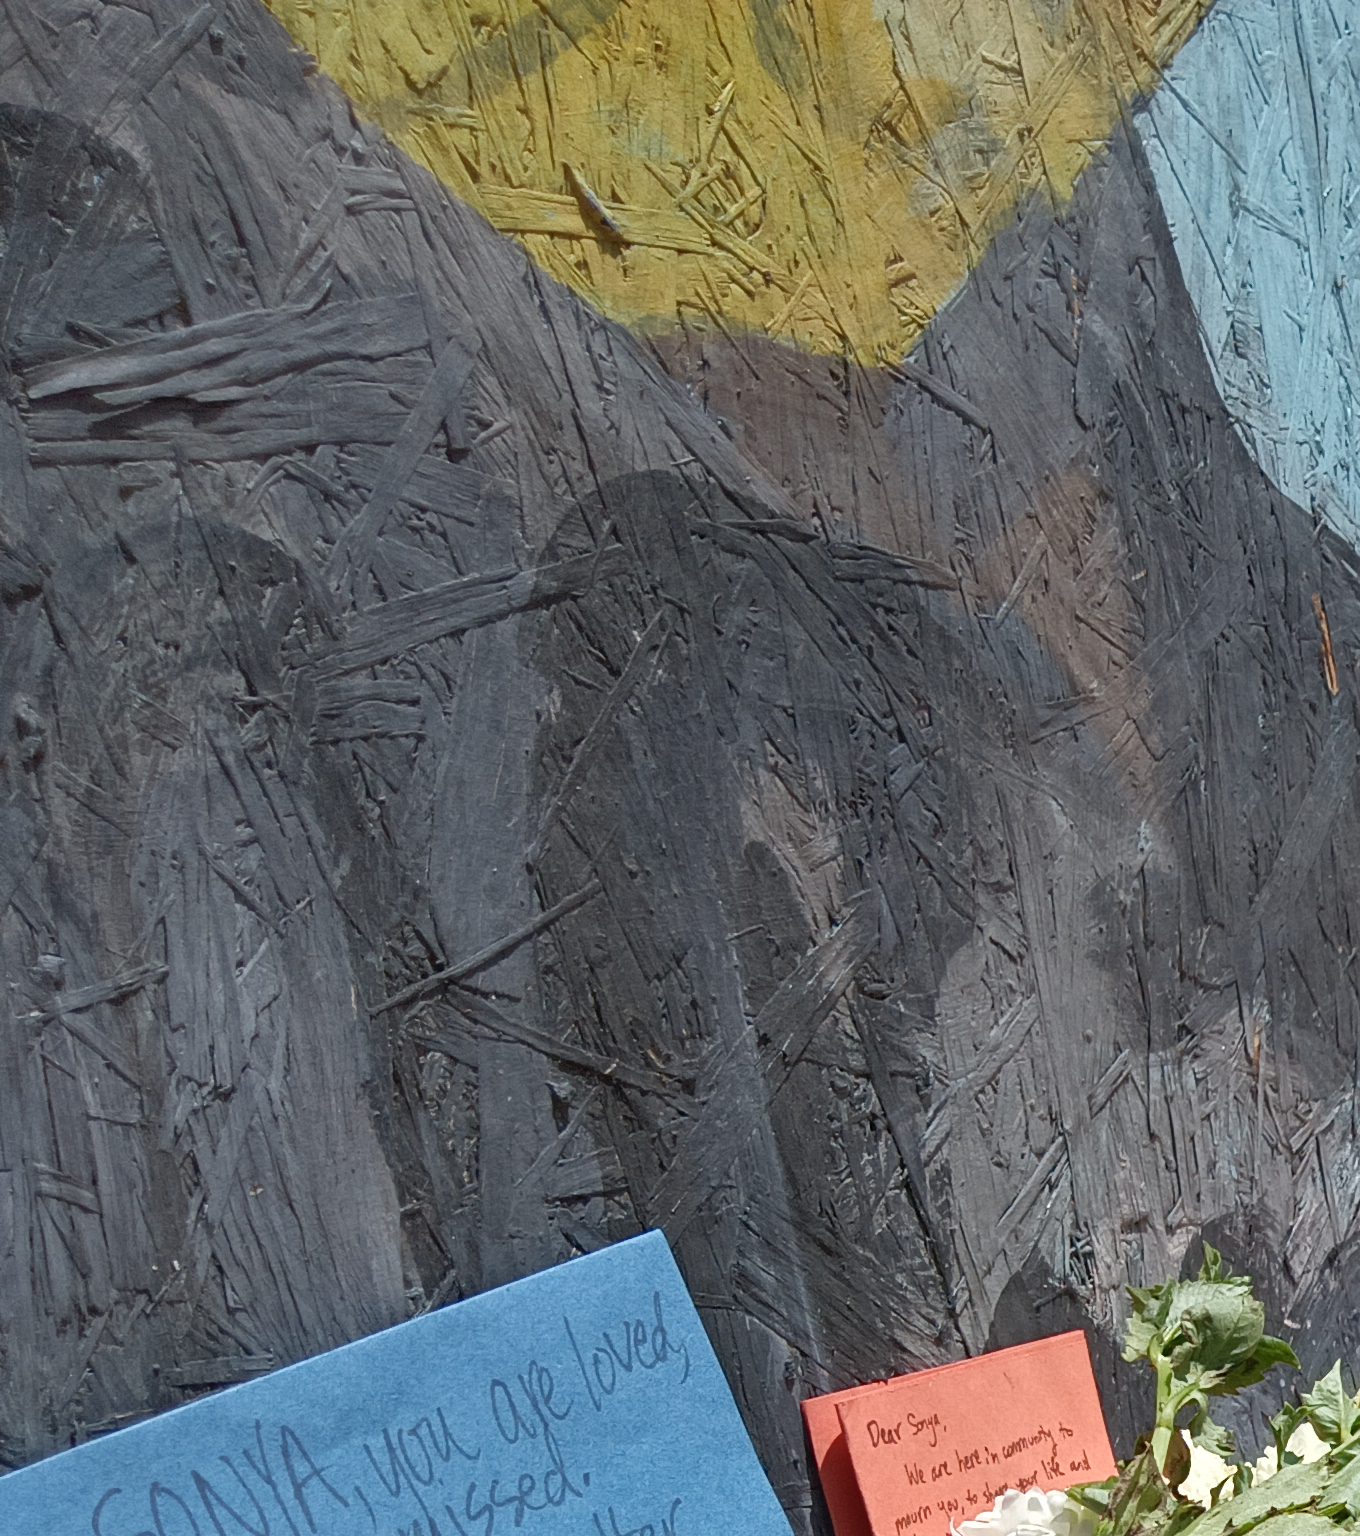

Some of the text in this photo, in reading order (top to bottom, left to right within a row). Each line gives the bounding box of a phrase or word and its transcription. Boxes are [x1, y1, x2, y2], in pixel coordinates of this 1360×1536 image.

[366, 1409, 480, 1503] you
[496, 1362, 576, 1457] are
[563, 1292, 692, 1419] loved,
[866, 1419, 903, 1448] Dear
[904, 1421, 1075, 1486] We are here in community to
[894, 1504, 934, 1536] mourn
[936, 1499, 967, 1520] you,
[965, 1488, 979, 1507] to
[1014, 1469, 1039, 1494] your
[1040, 1454, 1066, 1481] life
[1069, 1449, 1093, 1473] and
